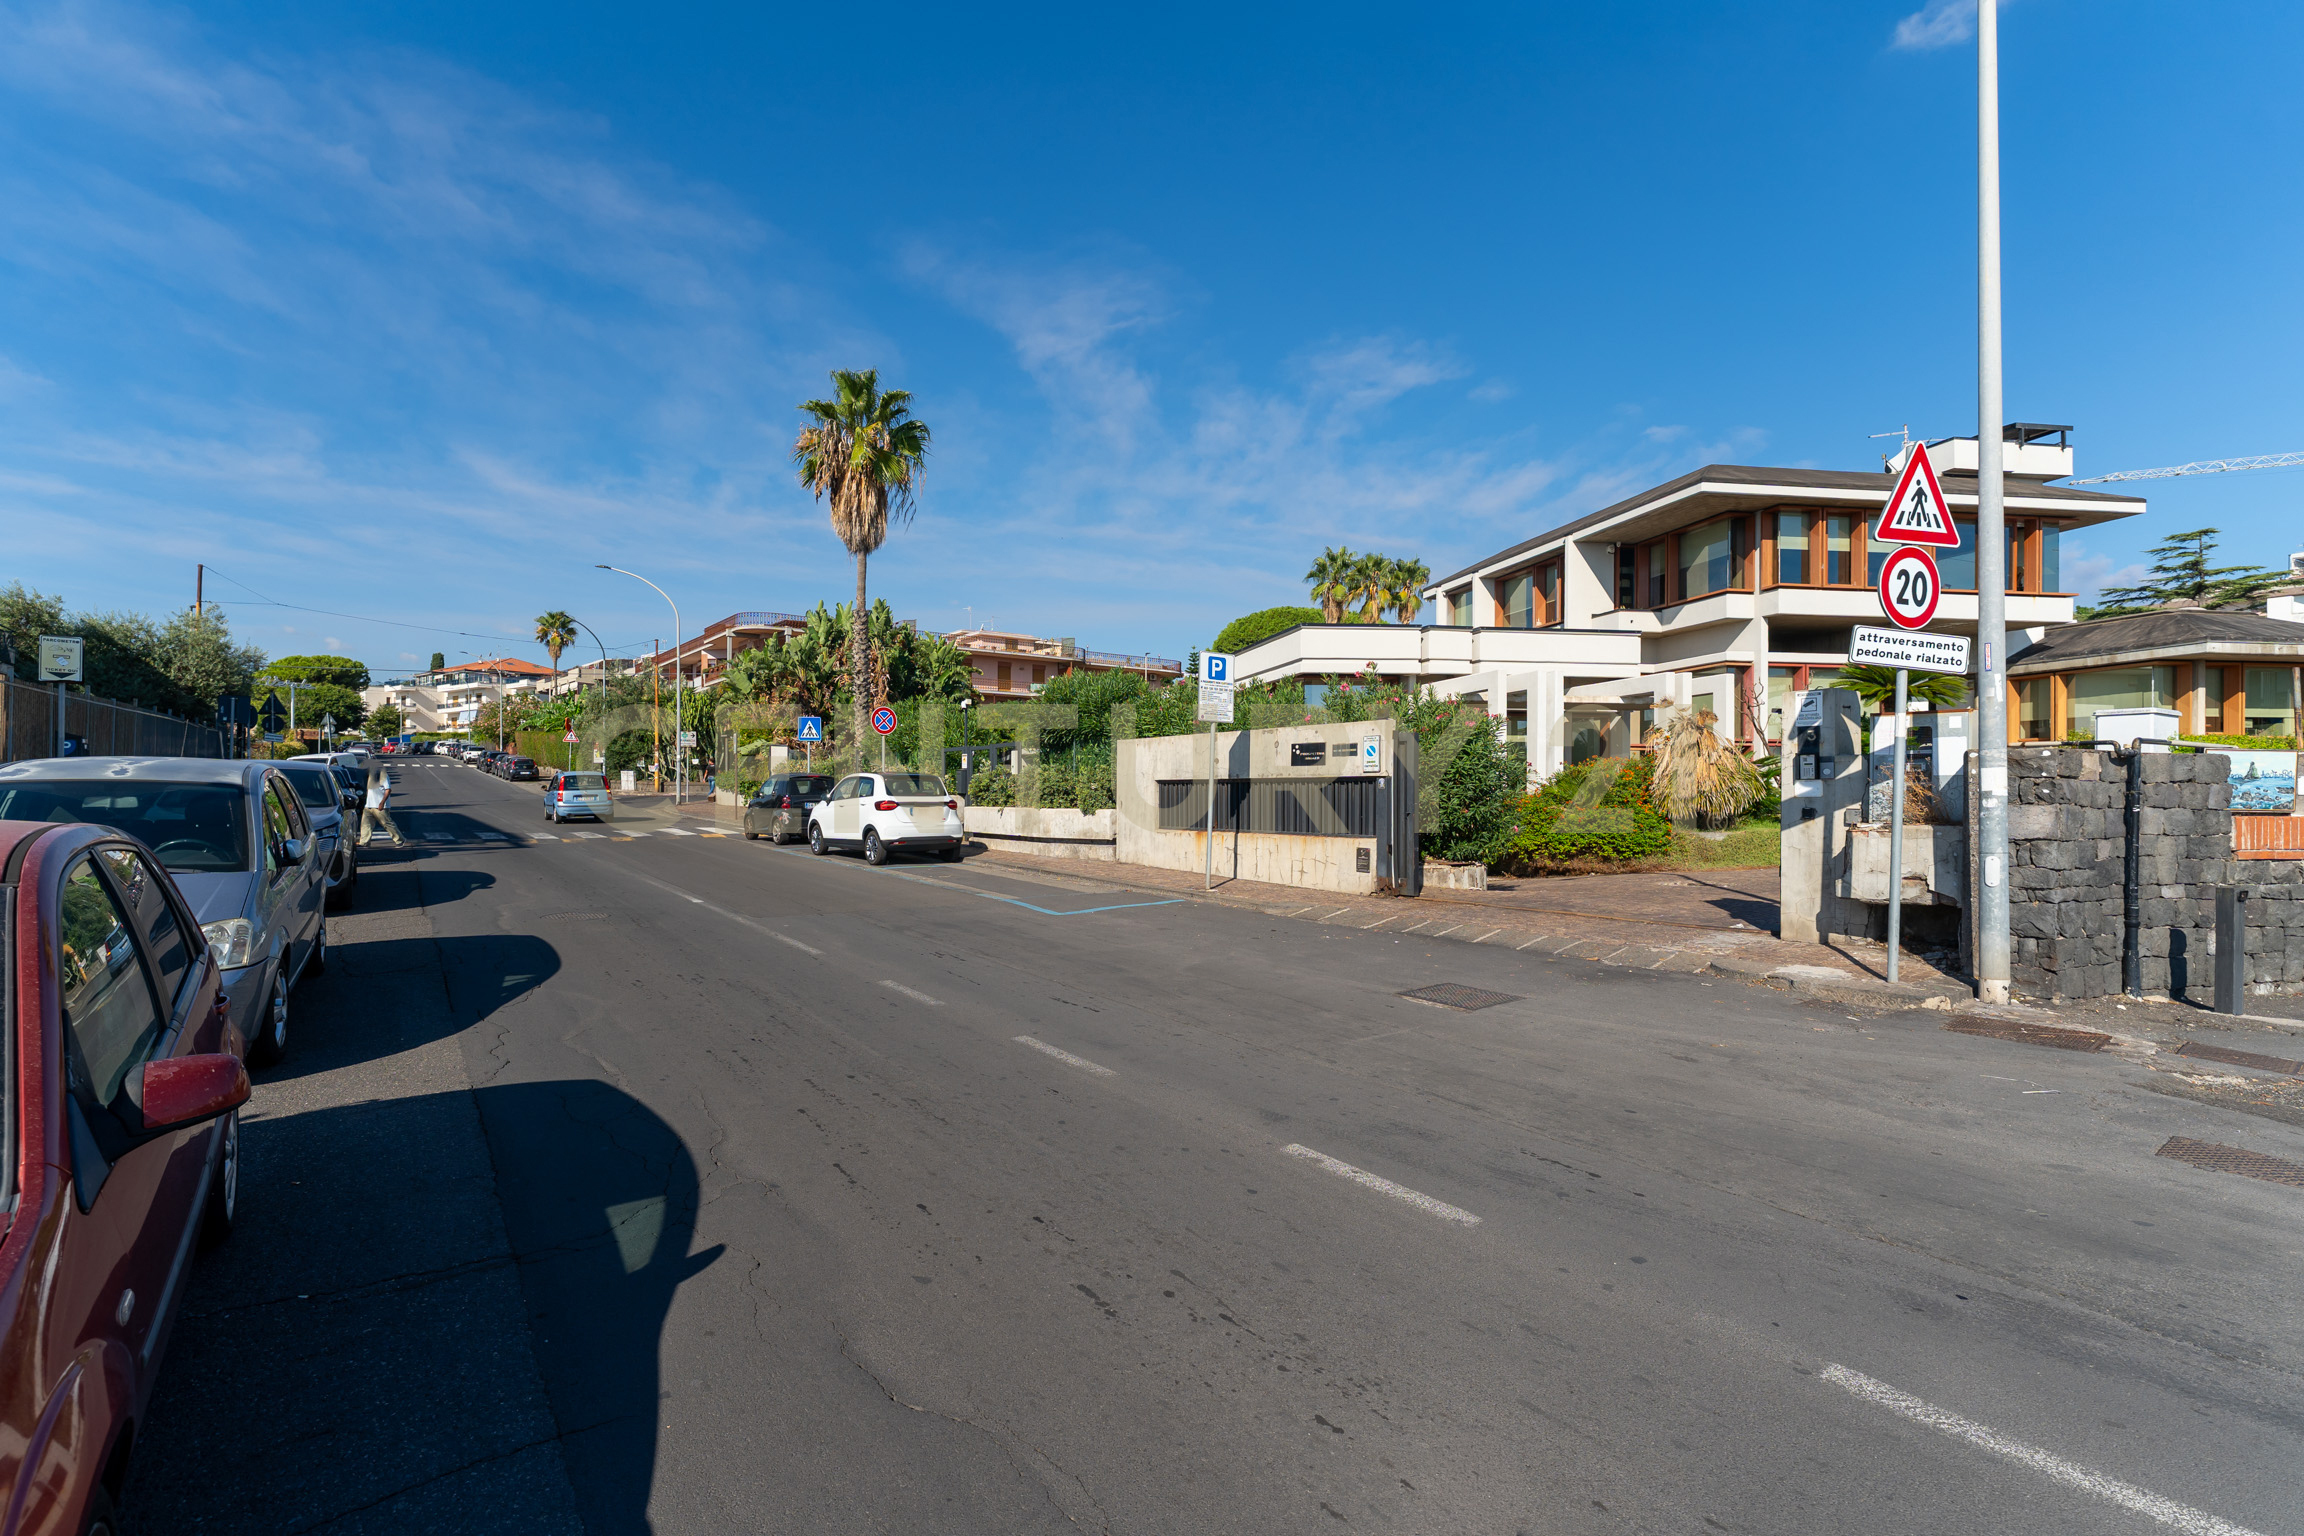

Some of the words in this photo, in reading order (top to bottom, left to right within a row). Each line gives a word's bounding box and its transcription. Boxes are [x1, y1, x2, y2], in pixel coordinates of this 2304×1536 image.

[1896, 568, 1928, 607] 20
[1859, 632, 1964, 652] attraversamento
[1856, 646, 1912, 661] pedonale
[1916, 653, 1962, 666] rialzato
[1211, 659, 1223, 678] P
[1807, 730, 1816, 741] 3
